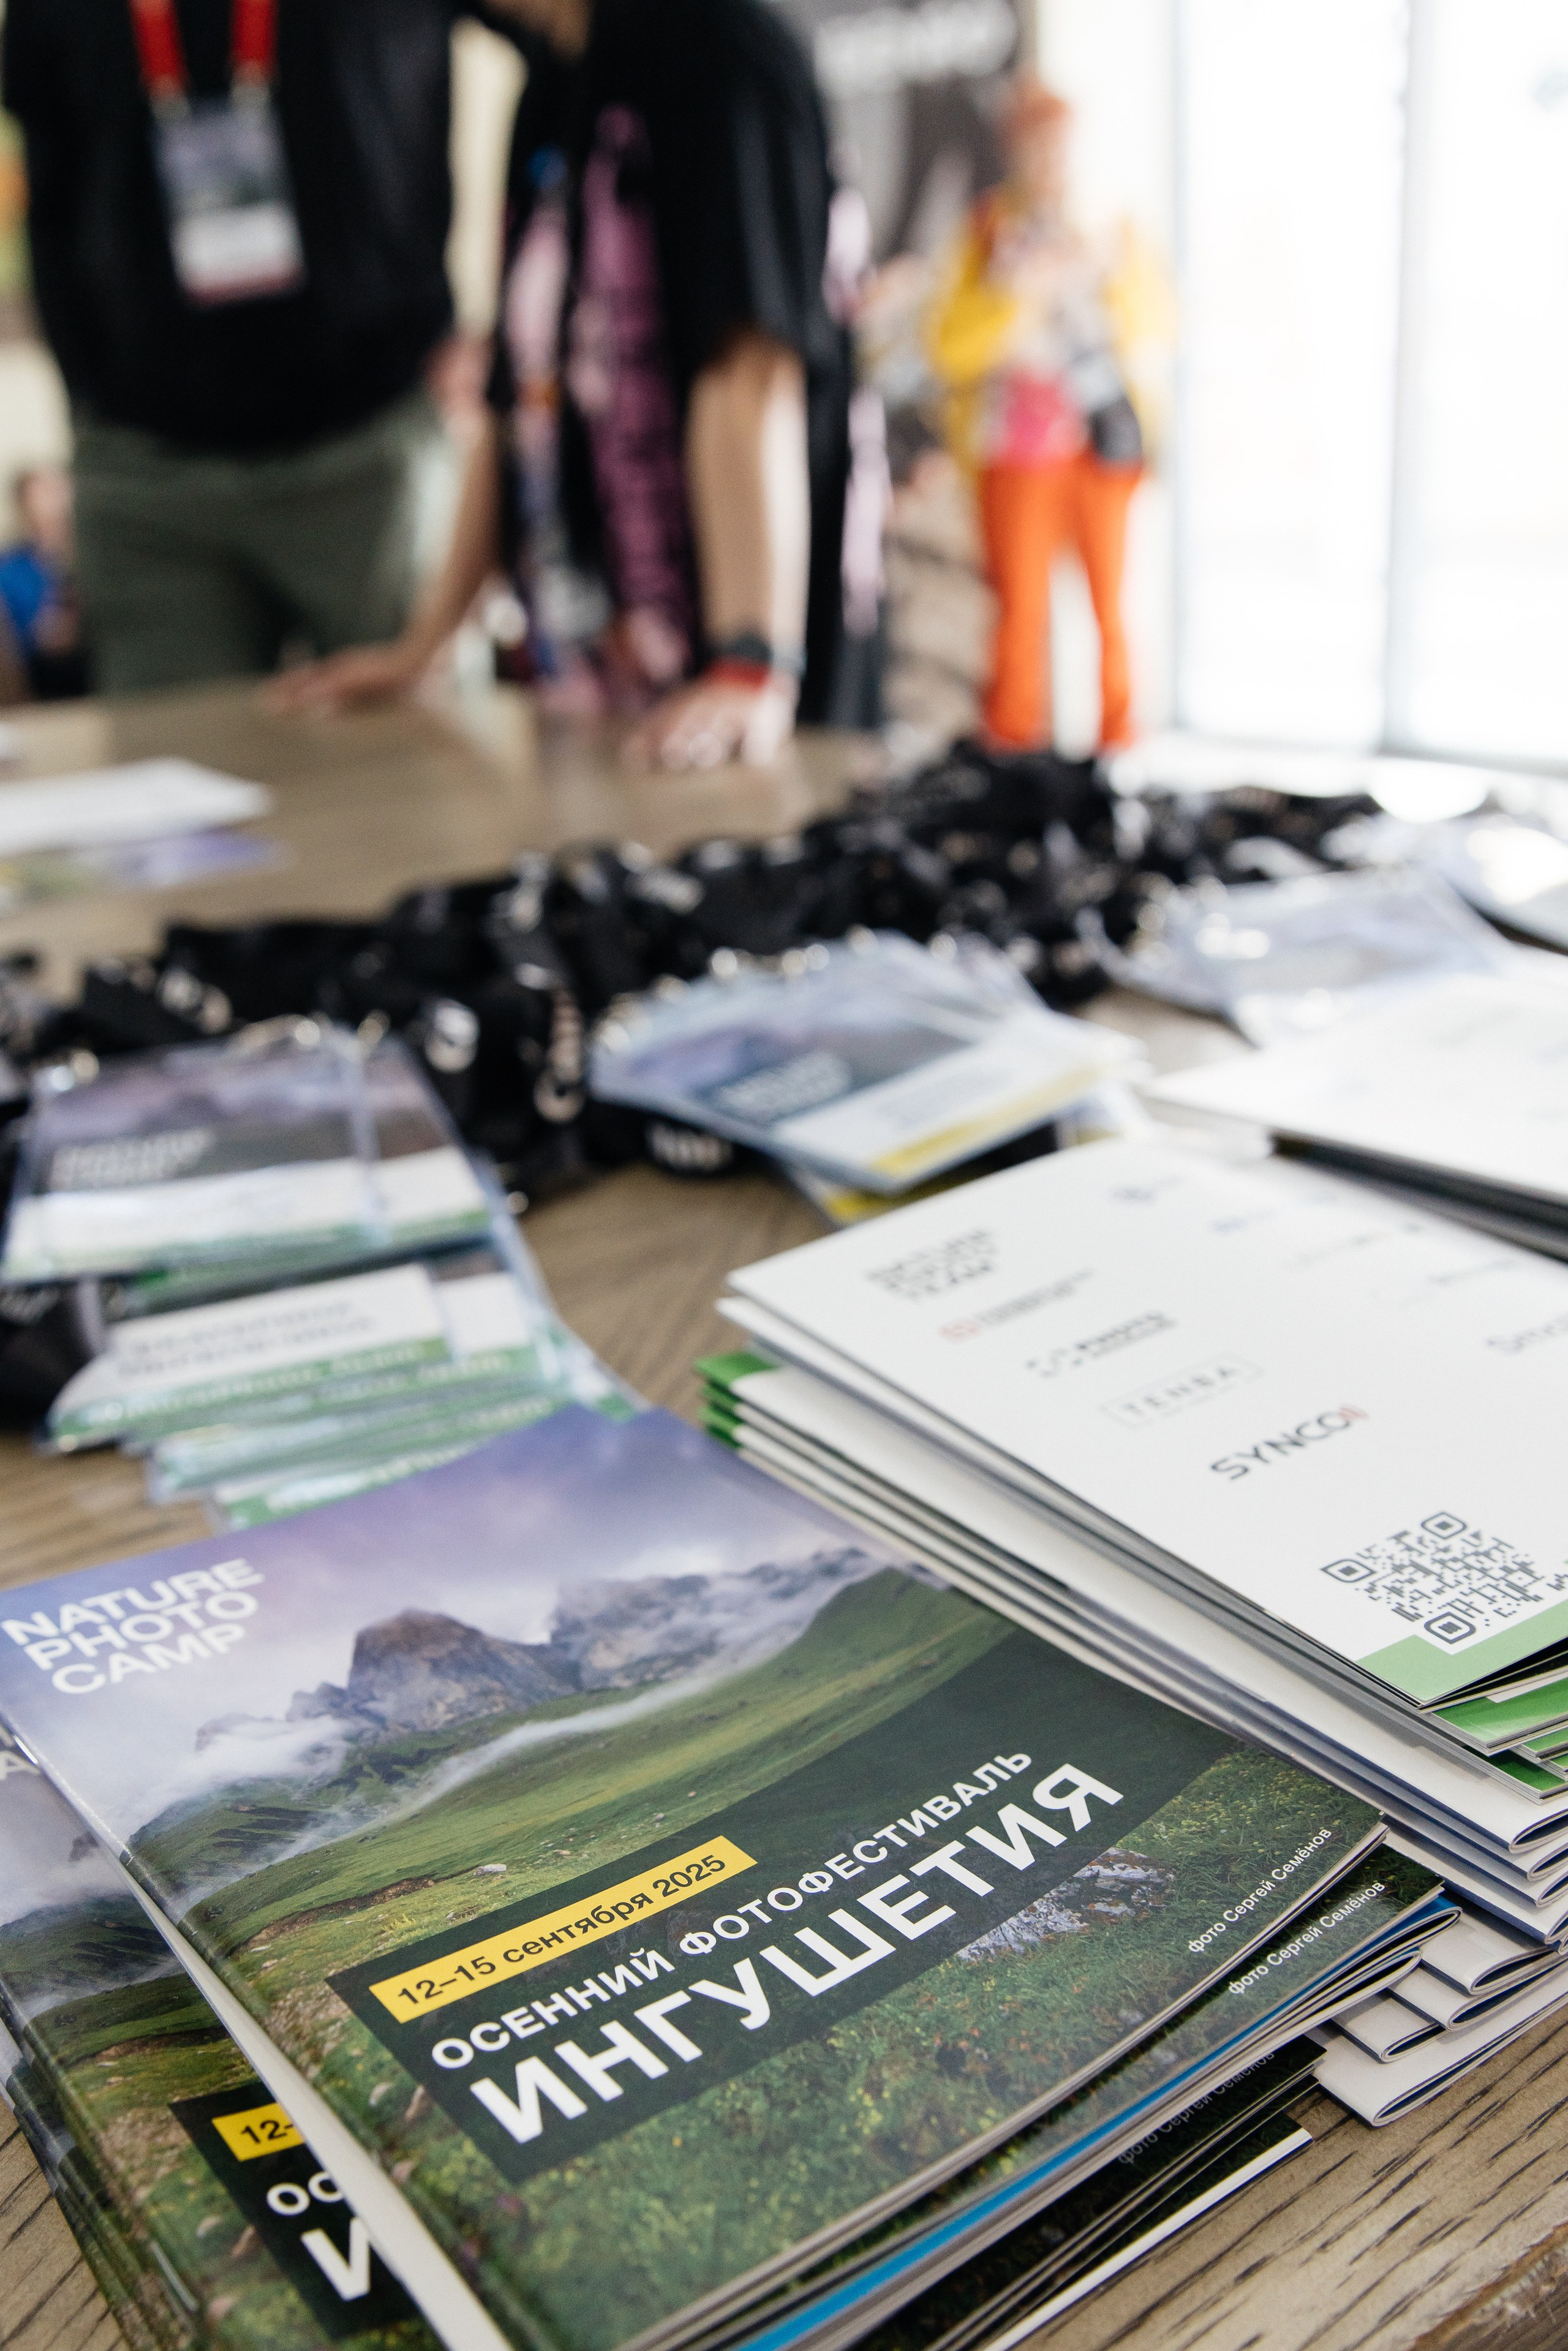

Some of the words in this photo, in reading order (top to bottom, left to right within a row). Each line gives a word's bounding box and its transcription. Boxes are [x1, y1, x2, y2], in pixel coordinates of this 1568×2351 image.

[1210, 1411, 1351, 1481] SYNCO
[1, 1558, 265, 1645] NATURE
[23, 1591, 259, 1671] PHOTO
[51, 1623, 246, 1694] CAMP
[431, 1947, 676, 2069] ОСЕННИЙ
[679, 1751, 1033, 1955] ФОТОФЕСТИВАЛЬ
[502, 1891, 654, 1963] сентября
[652, 1855, 727, 1898] 2025
[1188, 1922, 1226, 1953] фото
[1223, 1879, 1276, 1922] Сергей
[1272, 1828, 1332, 1881] Семёнов
[1228, 1965, 1269, 1994] фото
[1267, 1925, 1323, 1965] Сергей
[1319, 1882, 1385, 1928] Семёнов
[469, 1762, 1125, 2144] ИНГУШЕТИЯ
